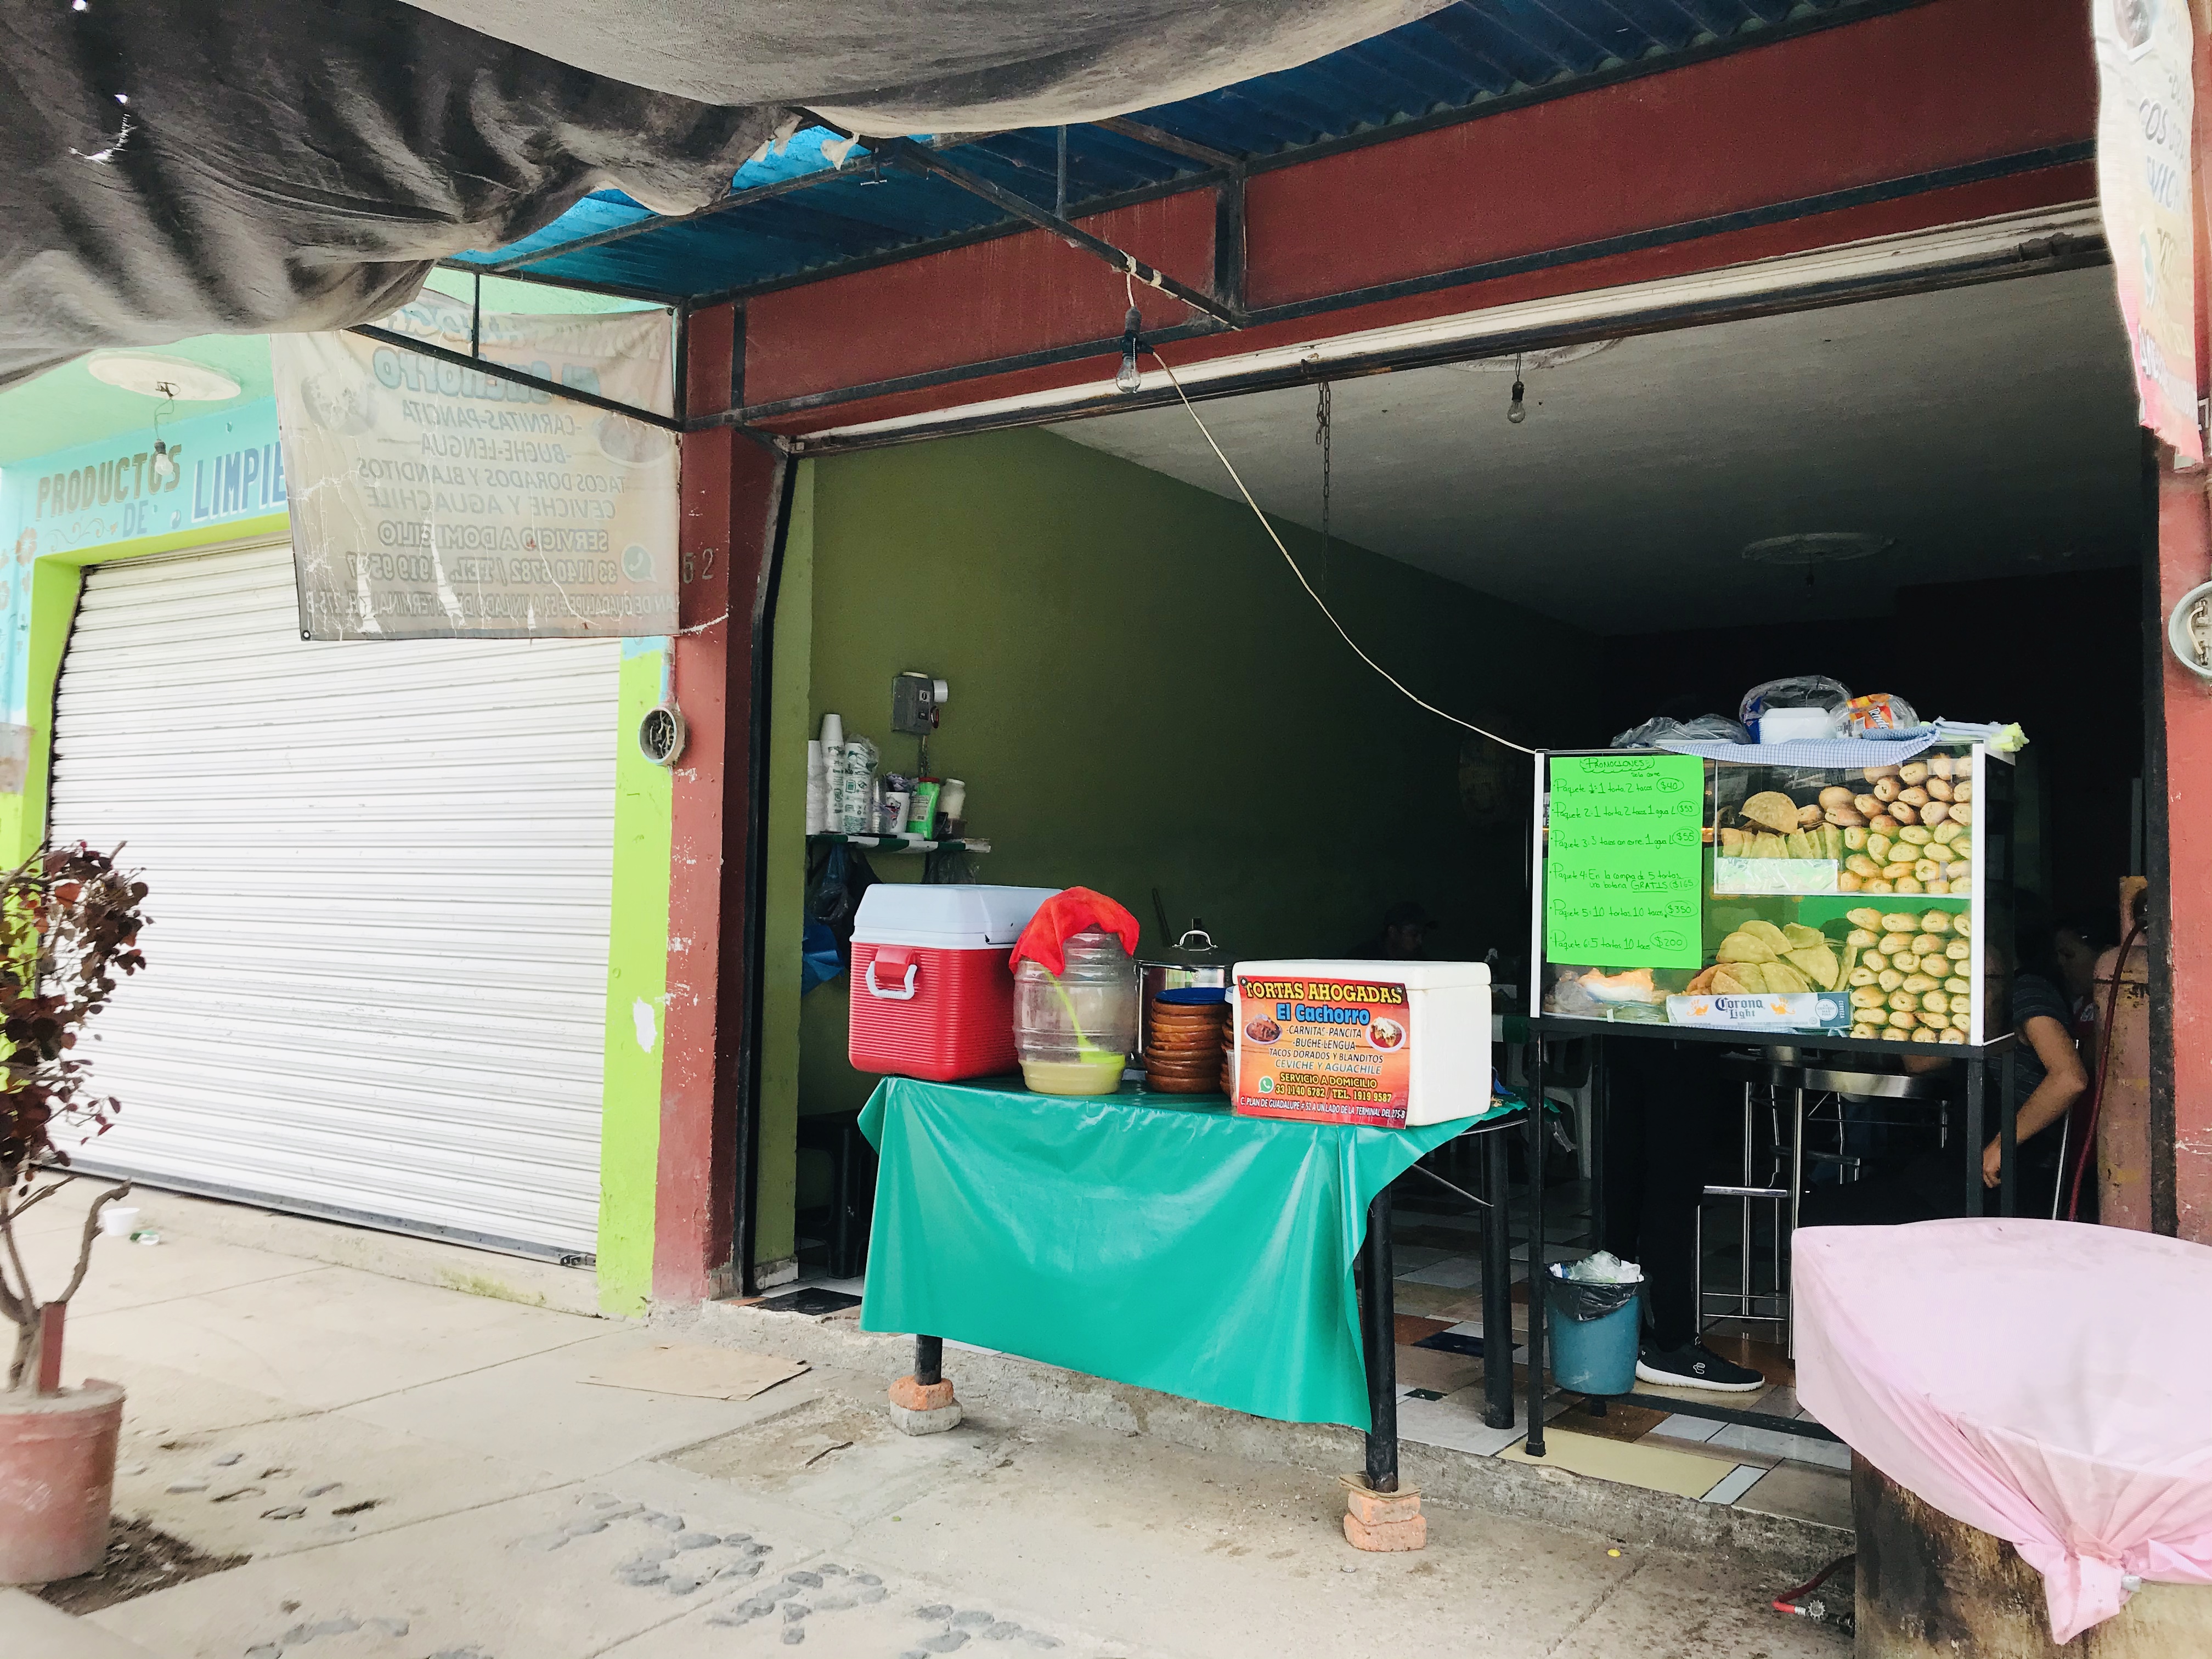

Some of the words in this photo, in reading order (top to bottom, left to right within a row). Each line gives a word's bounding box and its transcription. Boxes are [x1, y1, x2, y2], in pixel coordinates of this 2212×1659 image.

[122, 499, 149, 538] DE
[1554, 778, 1585, 797] Paquete
[1598, 782, 1606, 794] 1
[1626, 783, 1634, 793] 2
[1636, 783, 1652, 792] tacos
[1660, 781, 1678, 791] $40
[1554, 802, 1581, 821] Paquete
[1594, 805, 1601, 817] 1
[1624, 806, 1632, 816] 2
[1648, 804, 1655, 815] 1
[1656, 809, 1669, 818] agua
[1552, 830, 1579, 850] Paquete
[1591, 836, 1597, 845] 3
[1645, 833, 1654, 845] 1
[1654, 839, 1667, 849] agua
[1676, 832, 1695, 842] $55
[1551, 862, 1578, 882] Paquete
[1589, 868, 1600, 880] En
[1613, 873, 1636, 882] compra
[1638, 870, 1645, 880] de
[1648, 871, 1655, 880] 5
[1630, 879, 1668, 890] GRATIS
[1672, 879, 1694, 888] $165
[1553, 899, 1579, 920] Paquete
[1593, 906, 1605, 917] 10
[1633, 906, 1644, 917] 10
[1667, 904, 1691, 914] $350
[1551, 929, 1581, 951] Paquete
[1590, 938, 1598, 948] 5
[1624, 938, 1634, 950] 10
[1654, 935, 1683, 948] $200
[1245, 981, 1305, 1001] TORTAS
[1308, 982, 1403, 1005] AHOGADAS
[1276, 1002, 1291, 1021] El
[1295, 1003, 1370, 1026] Cachorro
[1715, 997, 1764, 1012] Corona
[1729, 1009, 1756, 1019] Light
[1269, 1048, 1291, 1057] TACOS
[1293, 1050, 1330, 1060] DORADOS
[1339, 1053, 1383, 1063] BLANDITOS
[1276, 1059, 1314, 1070] CEVICHE
[1317, 1062, 1323, 1070] Y
[1325, 1063, 1382, 1075] AGUACHILE
[1280, 1071, 1319, 1084] SERVICIO
[1321, 1075, 1328, 1085] A
[1329, 1075, 1378, 1089] DOMICILIO
[1275, 1084, 1285, 1094] 33
[1287, 1085, 1305, 1096] 1140
[1307, 1086, 1325, 1098] 6782
[1332, 1088, 1351, 1100] TEL.
[1353, 1090, 1372, 1102] 1919
[1373, 1092, 1392, 1103] 9587
[1246, 1097, 1260, 1107] PLAN
[1261, 1098, 1268, 1108] DE
[1269, 1099, 1300, 1110] GUADALUPE
[1312, 1102, 1316, 1112] A
[1317, 1102, 1325, 1112] UN
[1325, 1103, 1340, 1113] LADO
[1341, 1104, 1348, 1114] DE
[1348, 1105, 1355, 1114] LA
[1356, 1106, 1380, 1116] TERMINAL
[1381, 1109, 1391, 1118] DEL
